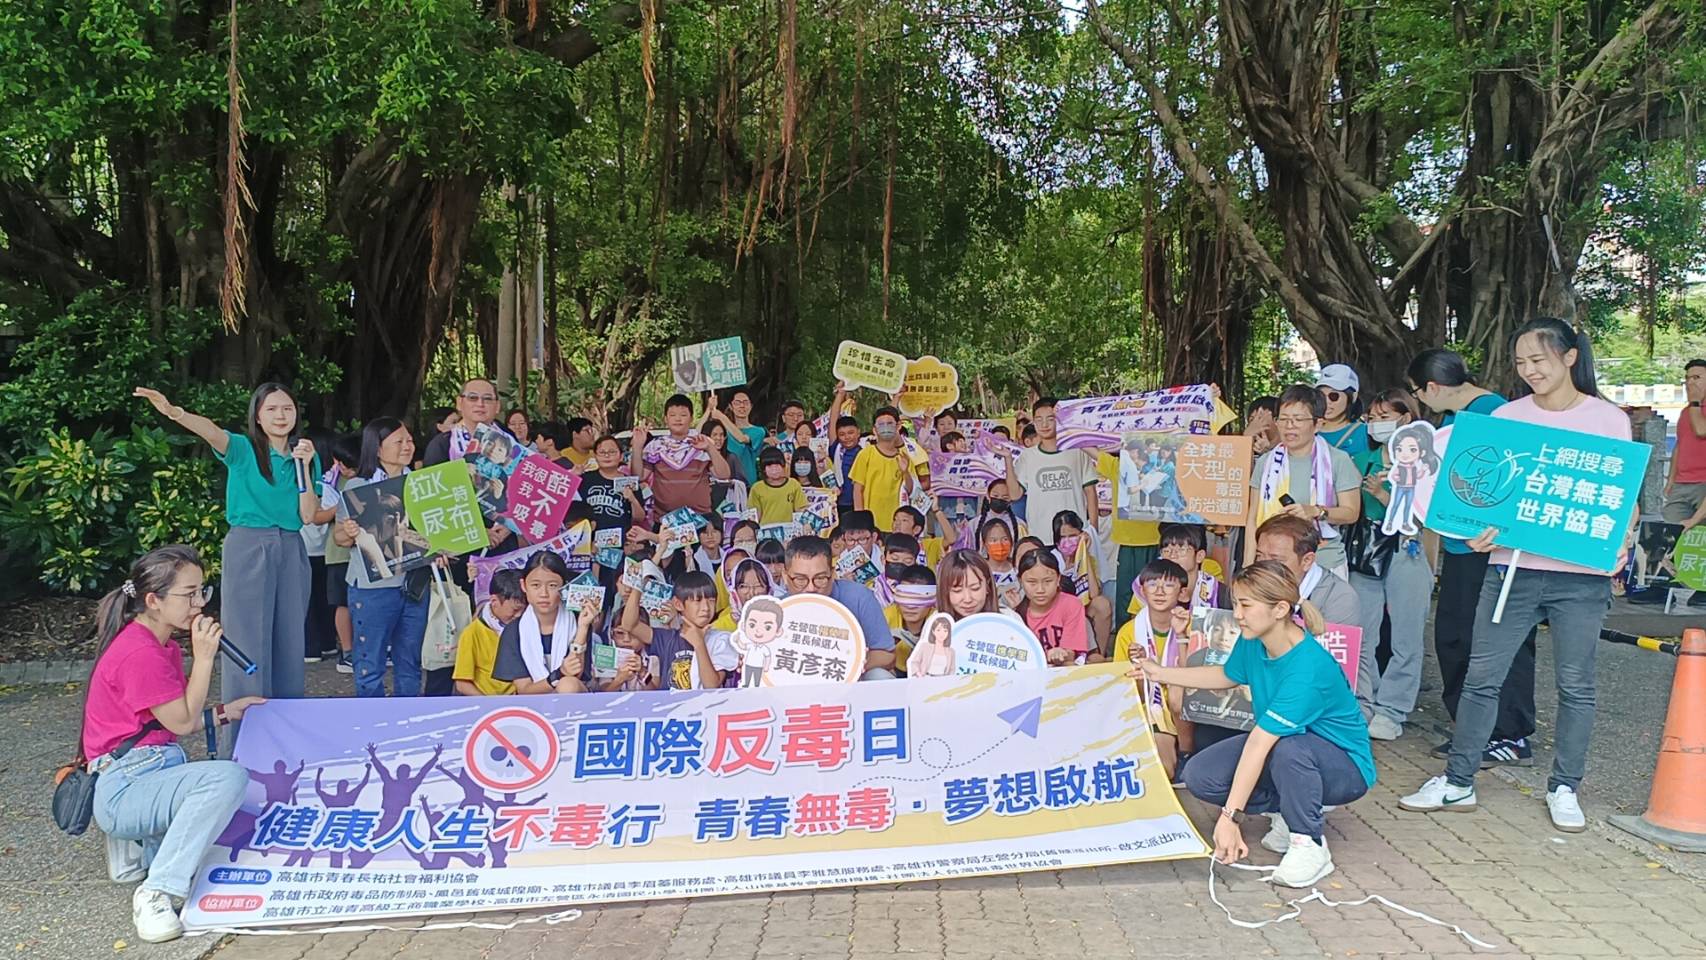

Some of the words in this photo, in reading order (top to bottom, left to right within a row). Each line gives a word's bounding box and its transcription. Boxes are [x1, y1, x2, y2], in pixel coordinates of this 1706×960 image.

[710, 352, 740, 371] 毒品
[1184, 442, 1234, 459] 全球最
[1531, 443, 1625, 477] 上網搜尋
[520, 461, 572, 497] 我很酷
[1042, 472, 1070, 482] RELAY
[1182, 460, 1243, 481] 大型的
[1216, 482, 1242, 497] 毒品
[1525, 470, 1625, 511] 台灣無毒
[1188, 498, 1242, 515] 防治運動
[1516, 498, 1616, 540] 世界協會
[791, 633, 841, 652] 里長候選人
[1036, 625, 1064, 651] AP
[774, 648, 847, 682] 黃彥森
[968, 652, 1017, 671] 里長候選人
[576, 704, 909, 779] 國際反毒日
[254, 803, 664, 851] 健康人生不毒行
[216, 871, 270, 883] 主辦單位
[204, 898, 257, 910] 協辦單位
